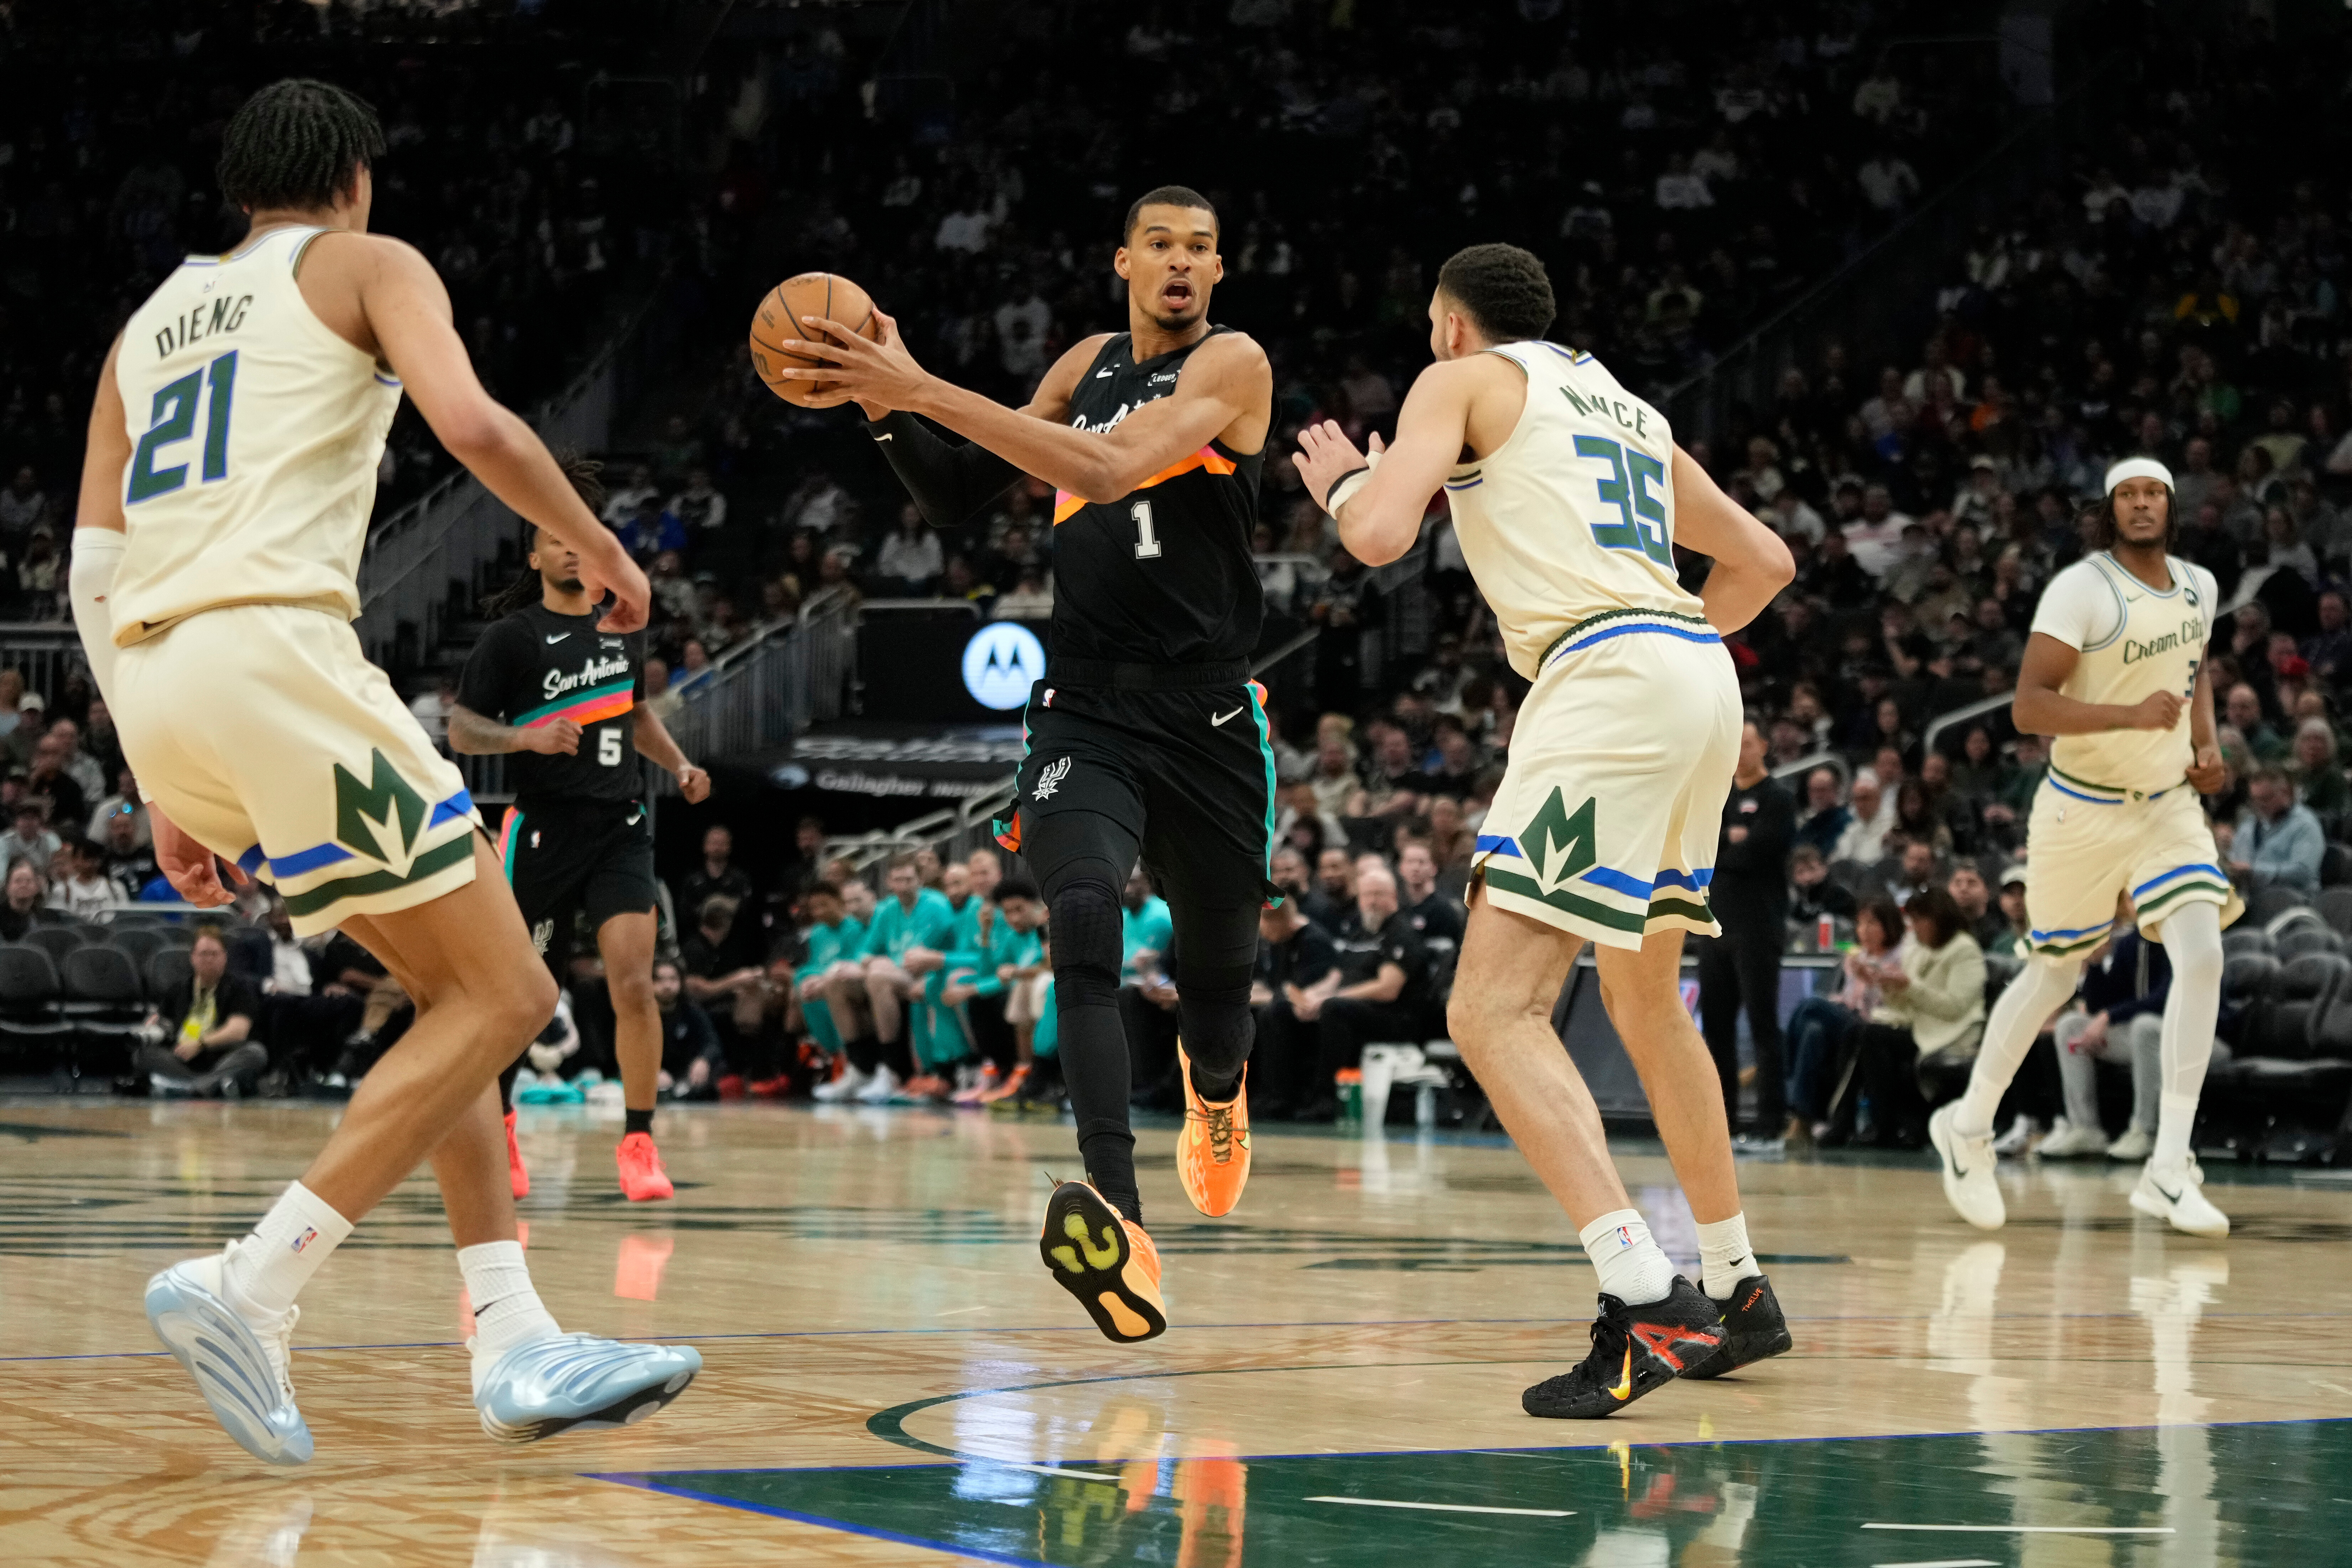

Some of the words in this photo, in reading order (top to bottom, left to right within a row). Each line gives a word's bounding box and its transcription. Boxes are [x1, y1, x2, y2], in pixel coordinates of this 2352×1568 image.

[155, 294, 253, 360] DIENG
[1152, 373, 1176, 382] LEDGER
[125, 349, 239, 507] 21
[1571, 434, 1676, 574] 35
[1130, 500, 1161, 559] 1
[2124, 640, 2179, 665] Cream
[2181, 617, 2203, 650] City
[542, 668, 578, 700] San
[579, 653, 630, 686] Antonio
[598, 728, 623, 767] 5
[1742, 1287, 1763, 1312] TWELVE
